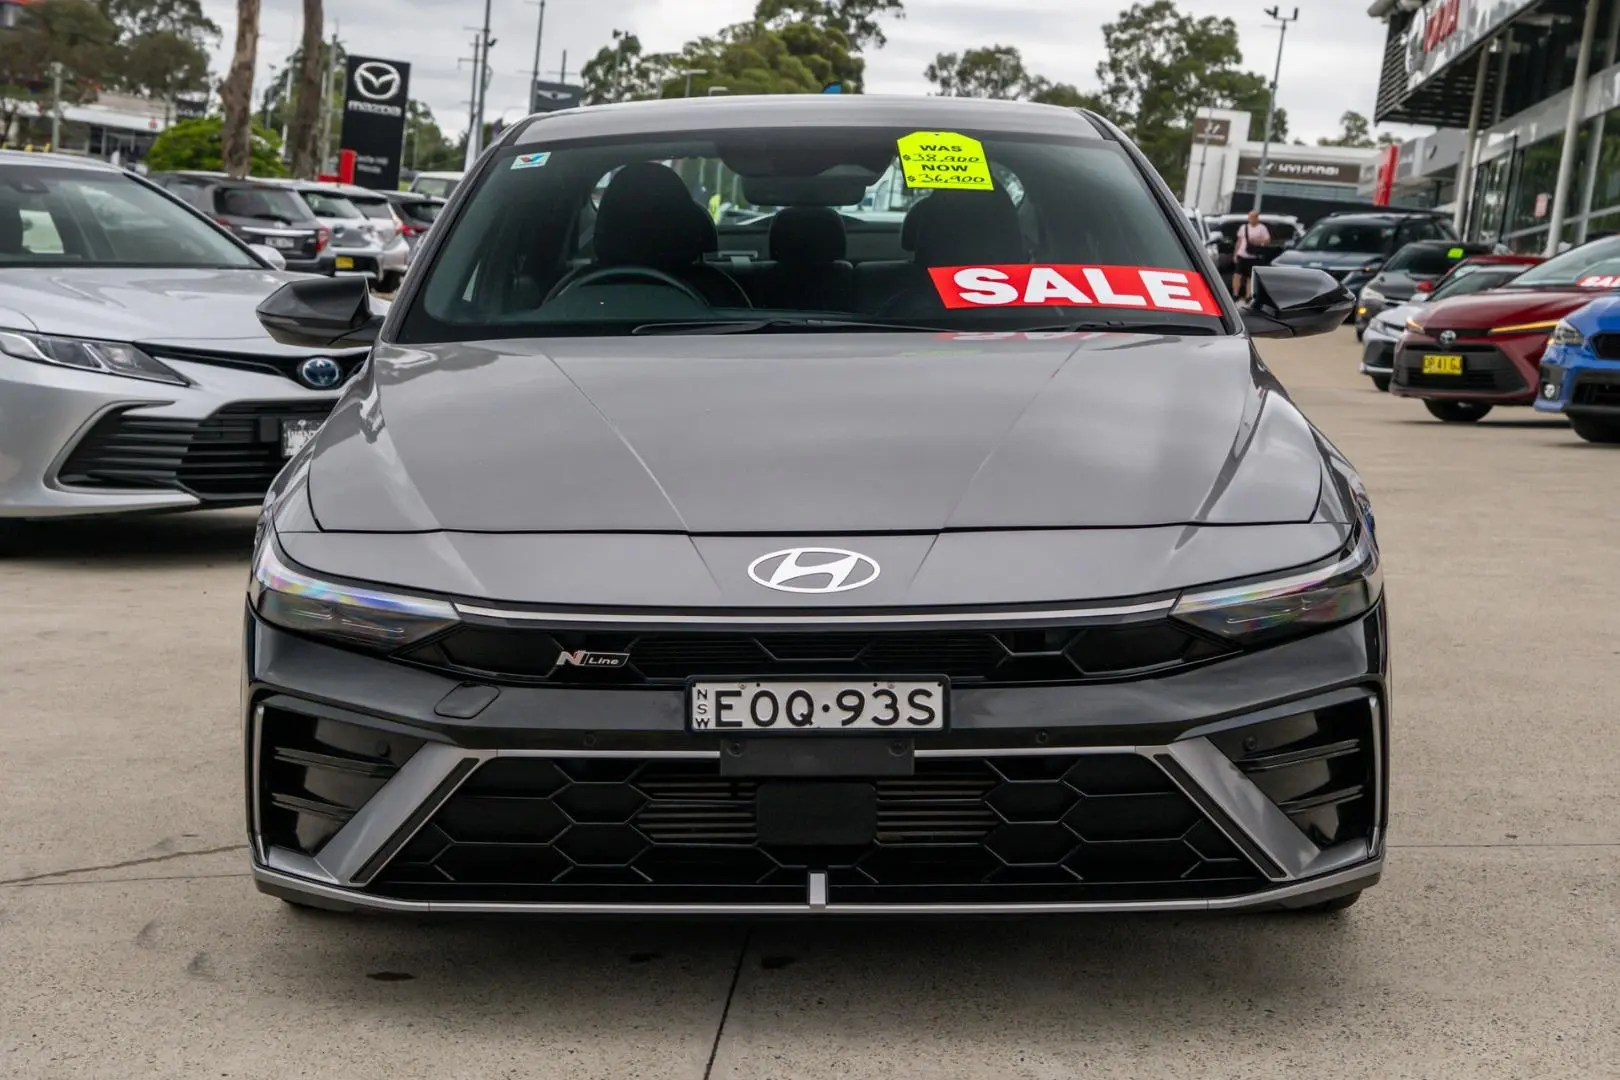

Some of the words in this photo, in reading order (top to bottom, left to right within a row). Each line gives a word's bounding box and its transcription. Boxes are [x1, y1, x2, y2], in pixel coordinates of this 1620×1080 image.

[921, 164, 968, 172] NOW
[953, 267, 1204, 312] SALE
[588, 657, 620, 665] Line
